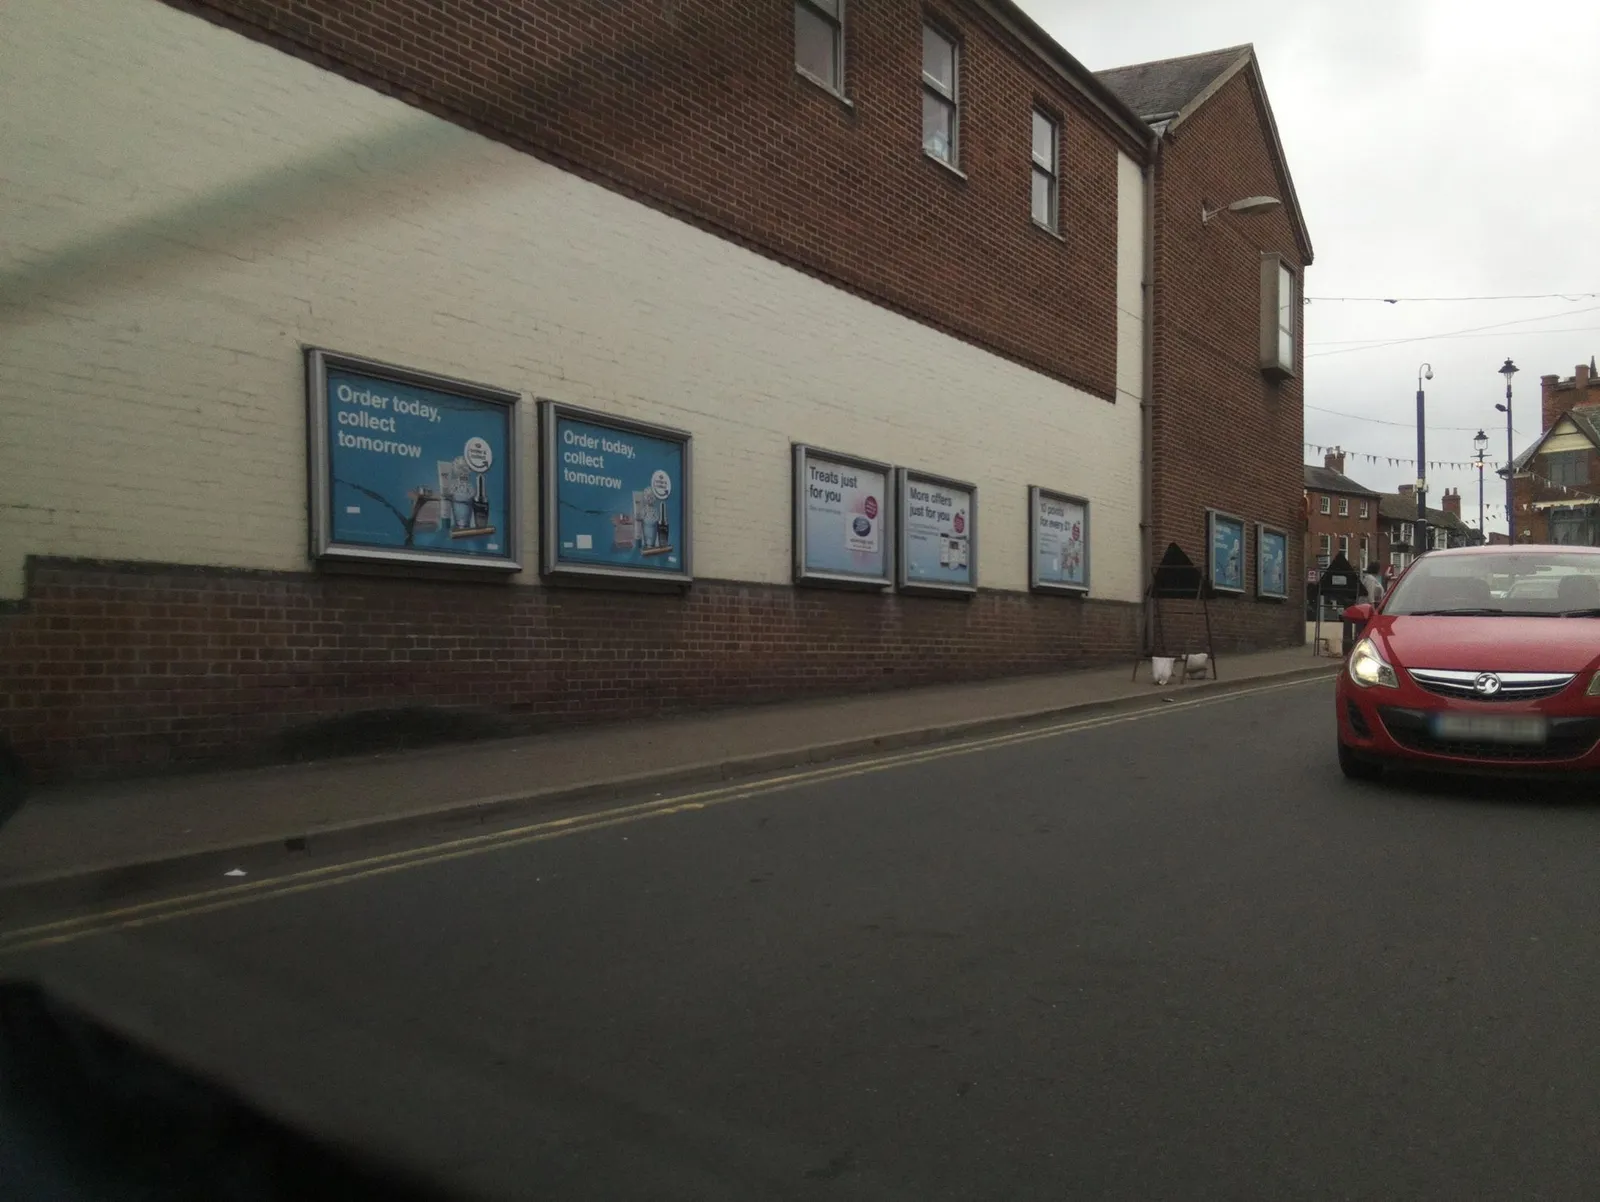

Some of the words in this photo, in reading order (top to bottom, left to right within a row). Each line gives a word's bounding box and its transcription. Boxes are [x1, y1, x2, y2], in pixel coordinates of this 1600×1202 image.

[337, 385, 389, 409] Order
[392, 396, 442, 423] today,
[337, 410, 396, 433] collect
[337, 430, 422, 458] tomorrow
[563, 430, 600, 449] Order
[601, 438, 636, 459] today,
[563, 451, 604, 469] collect
[563, 467, 622, 490] tomorrow
[809, 466, 839, 485] Treats
[840, 473, 858, 489] just
[809, 484, 823, 499] for
[824, 489, 842, 503] you
[909, 486, 929, 503] More
[930, 492, 952, 507] offers
[909, 502, 924, 518] just
[925, 505, 937, 520] for
[937, 511, 951, 523] you
